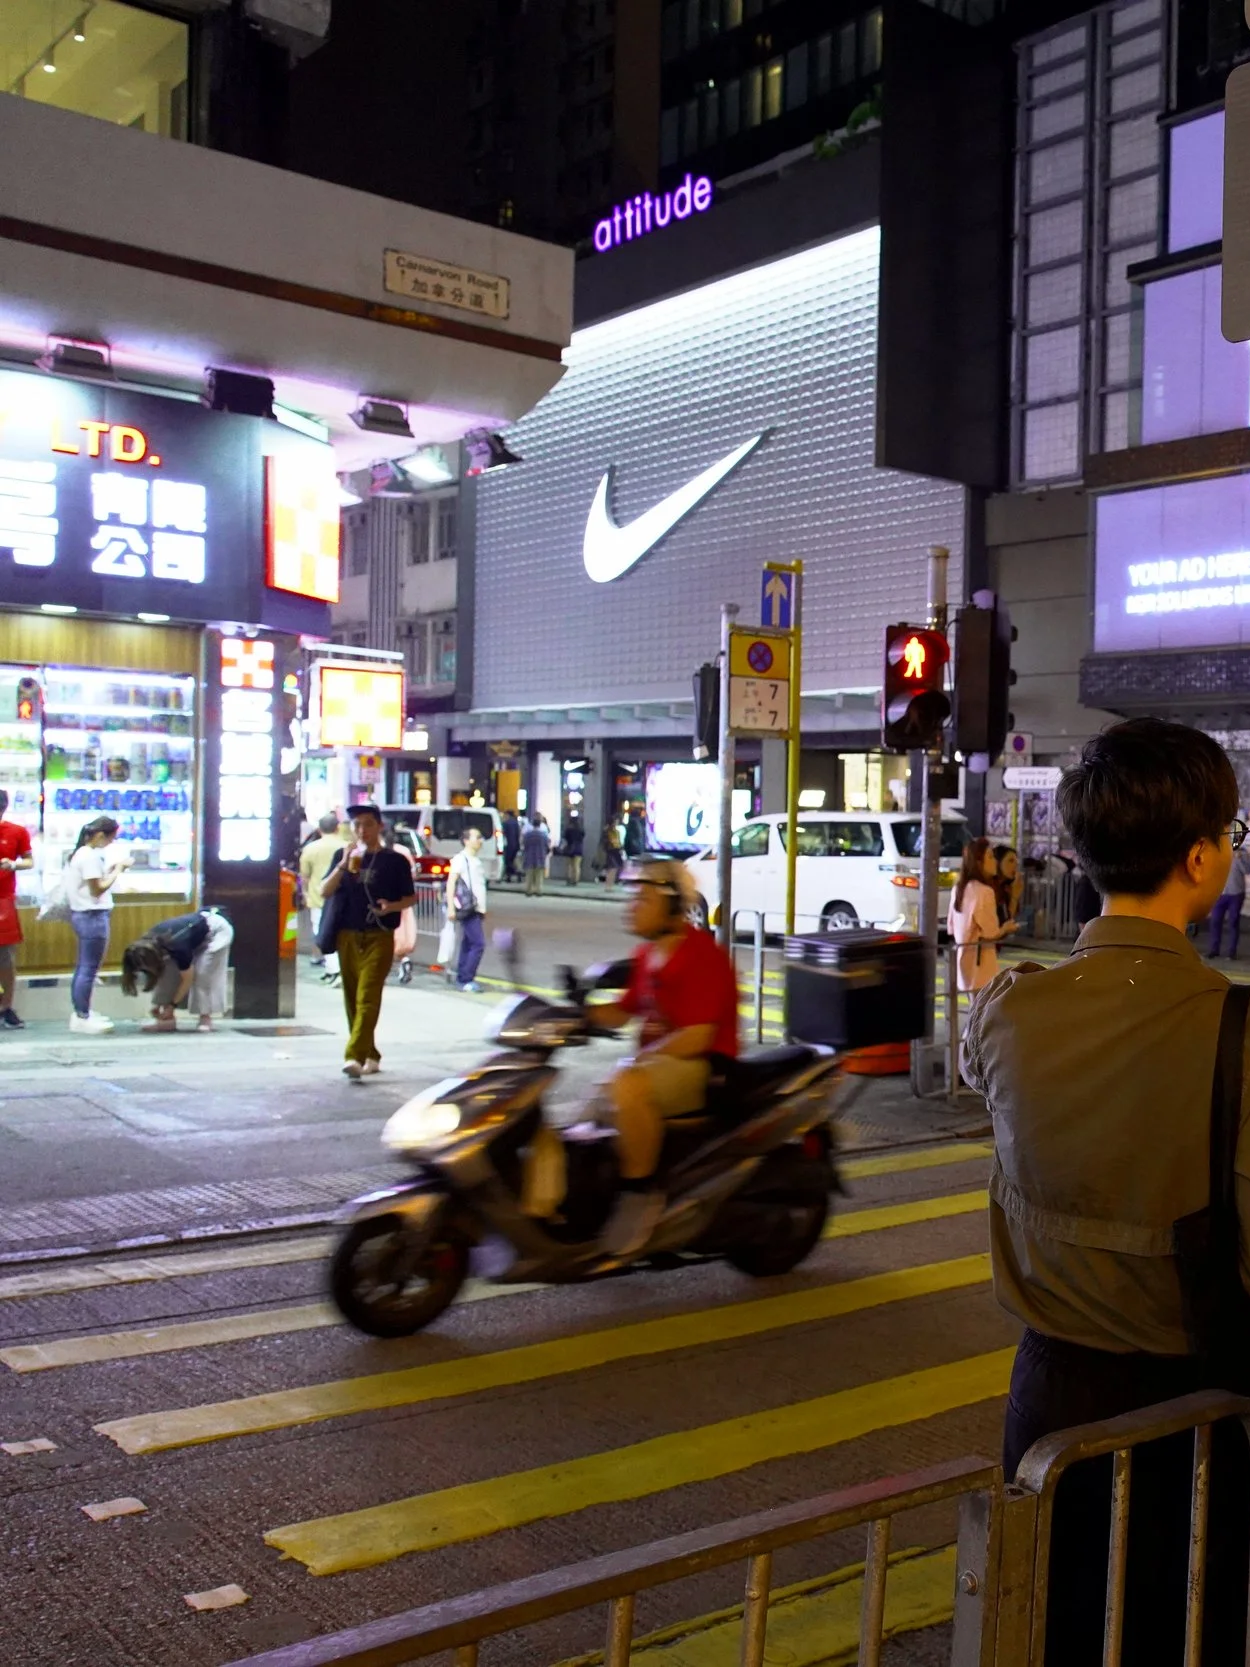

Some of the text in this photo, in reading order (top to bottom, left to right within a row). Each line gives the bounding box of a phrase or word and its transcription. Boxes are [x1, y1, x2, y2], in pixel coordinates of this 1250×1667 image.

[593, 172, 713, 252] attitude
[467, 273, 499, 291] Road
[50, 418, 161, 467] LTD.
[1128, 560, 1177, 587] YOUR
[1178, 556, 1206, 582] AD
[769, 683, 779, 700] 7
[768, 710, 778, 726] 7
